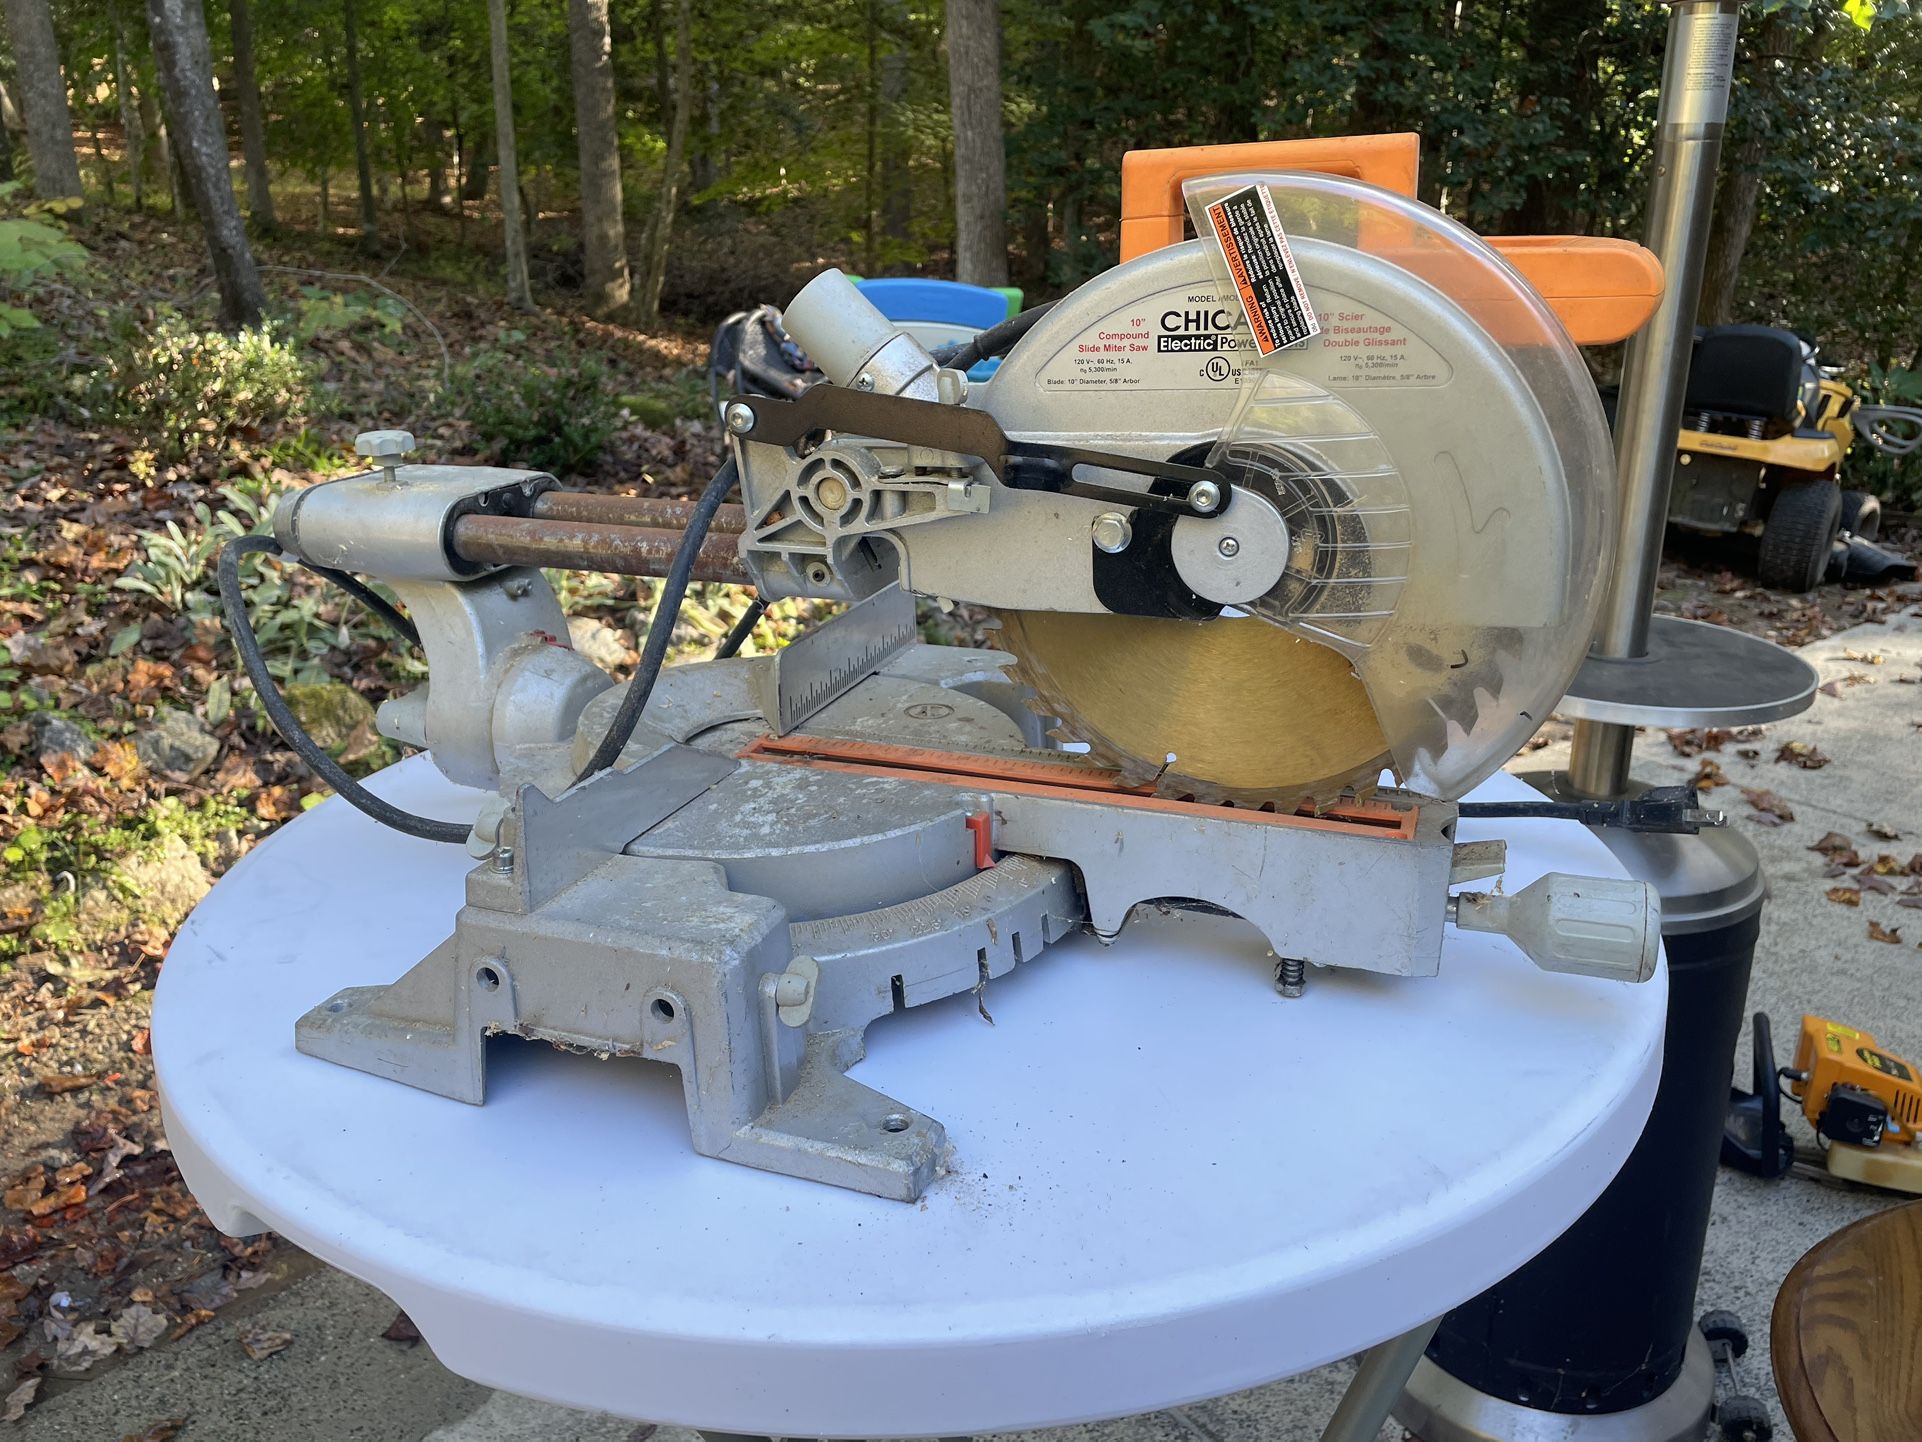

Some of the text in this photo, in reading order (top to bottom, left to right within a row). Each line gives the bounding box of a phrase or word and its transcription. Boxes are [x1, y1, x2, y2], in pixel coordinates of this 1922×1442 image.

[1212, 206, 1245, 278] AVERTISSEMENT
[1261, 284, 1272, 302] Return
[1267, 278, 1279, 300] position
[1160, 309, 1250, 332] CHICA
[1245, 294, 1266, 336] WARNING
[1259, 300, 1280, 347] To reduce risk of
[1338, 312, 1365, 321] Scier
[1098, 331, 1150, 341] Compound
[1275, 322, 1287, 344] serious
[1284, 324, 1295, 341] guard
[1333, 325, 1392, 335] Biseautage
[1078, 343, 1148, 352] Slide Miter Saw
[1160, 336, 1256, 351] Electric Powe
[1323, 338, 1407, 348] Double Glissant
